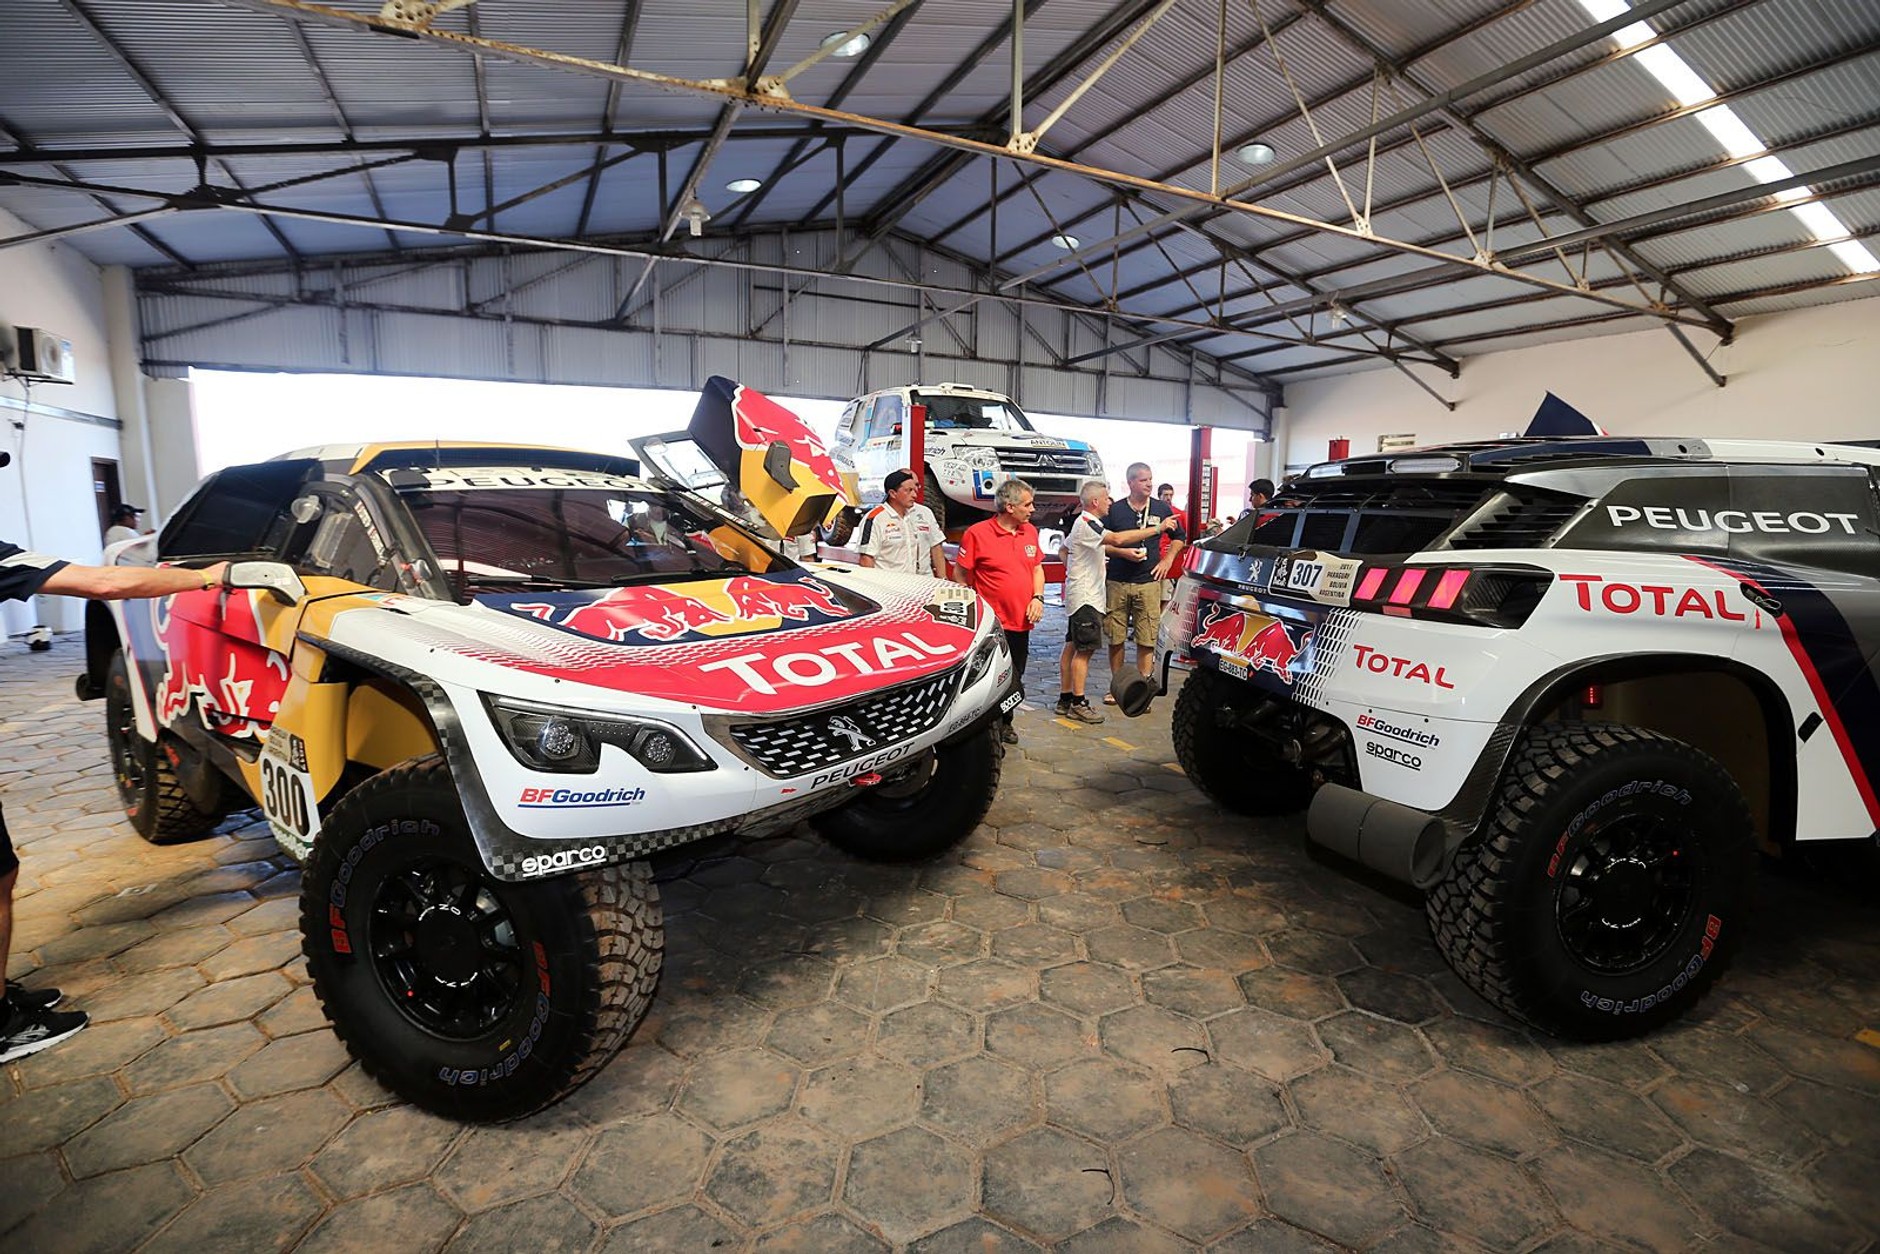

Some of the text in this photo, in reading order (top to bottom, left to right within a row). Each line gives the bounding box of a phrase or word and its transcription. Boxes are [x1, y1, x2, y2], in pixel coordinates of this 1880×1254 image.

[1606, 505, 1859, 535] PEUGEOT
[1238, 584, 1267, 594] PEUGEOT
[1292, 562, 1323, 588] 307
[1319, 588, 1345, 598] ARGENTINA
[1558, 574, 1746, 621] TOTAL
[698, 632, 957, 695] TOTAL
[1353, 644, 1455, 689] TOTAL
[1357, 714, 1440, 747] BFGoodrich
[810, 742, 914, 789] PEUGEOT
[1366, 741, 1422, 768] sparco
[263, 758, 310, 837] 300
[520, 787, 646, 803] BFGoodrich
[521, 844, 606, 875] sparco
[1580, 913, 1722, 1016] BFGoodrich
